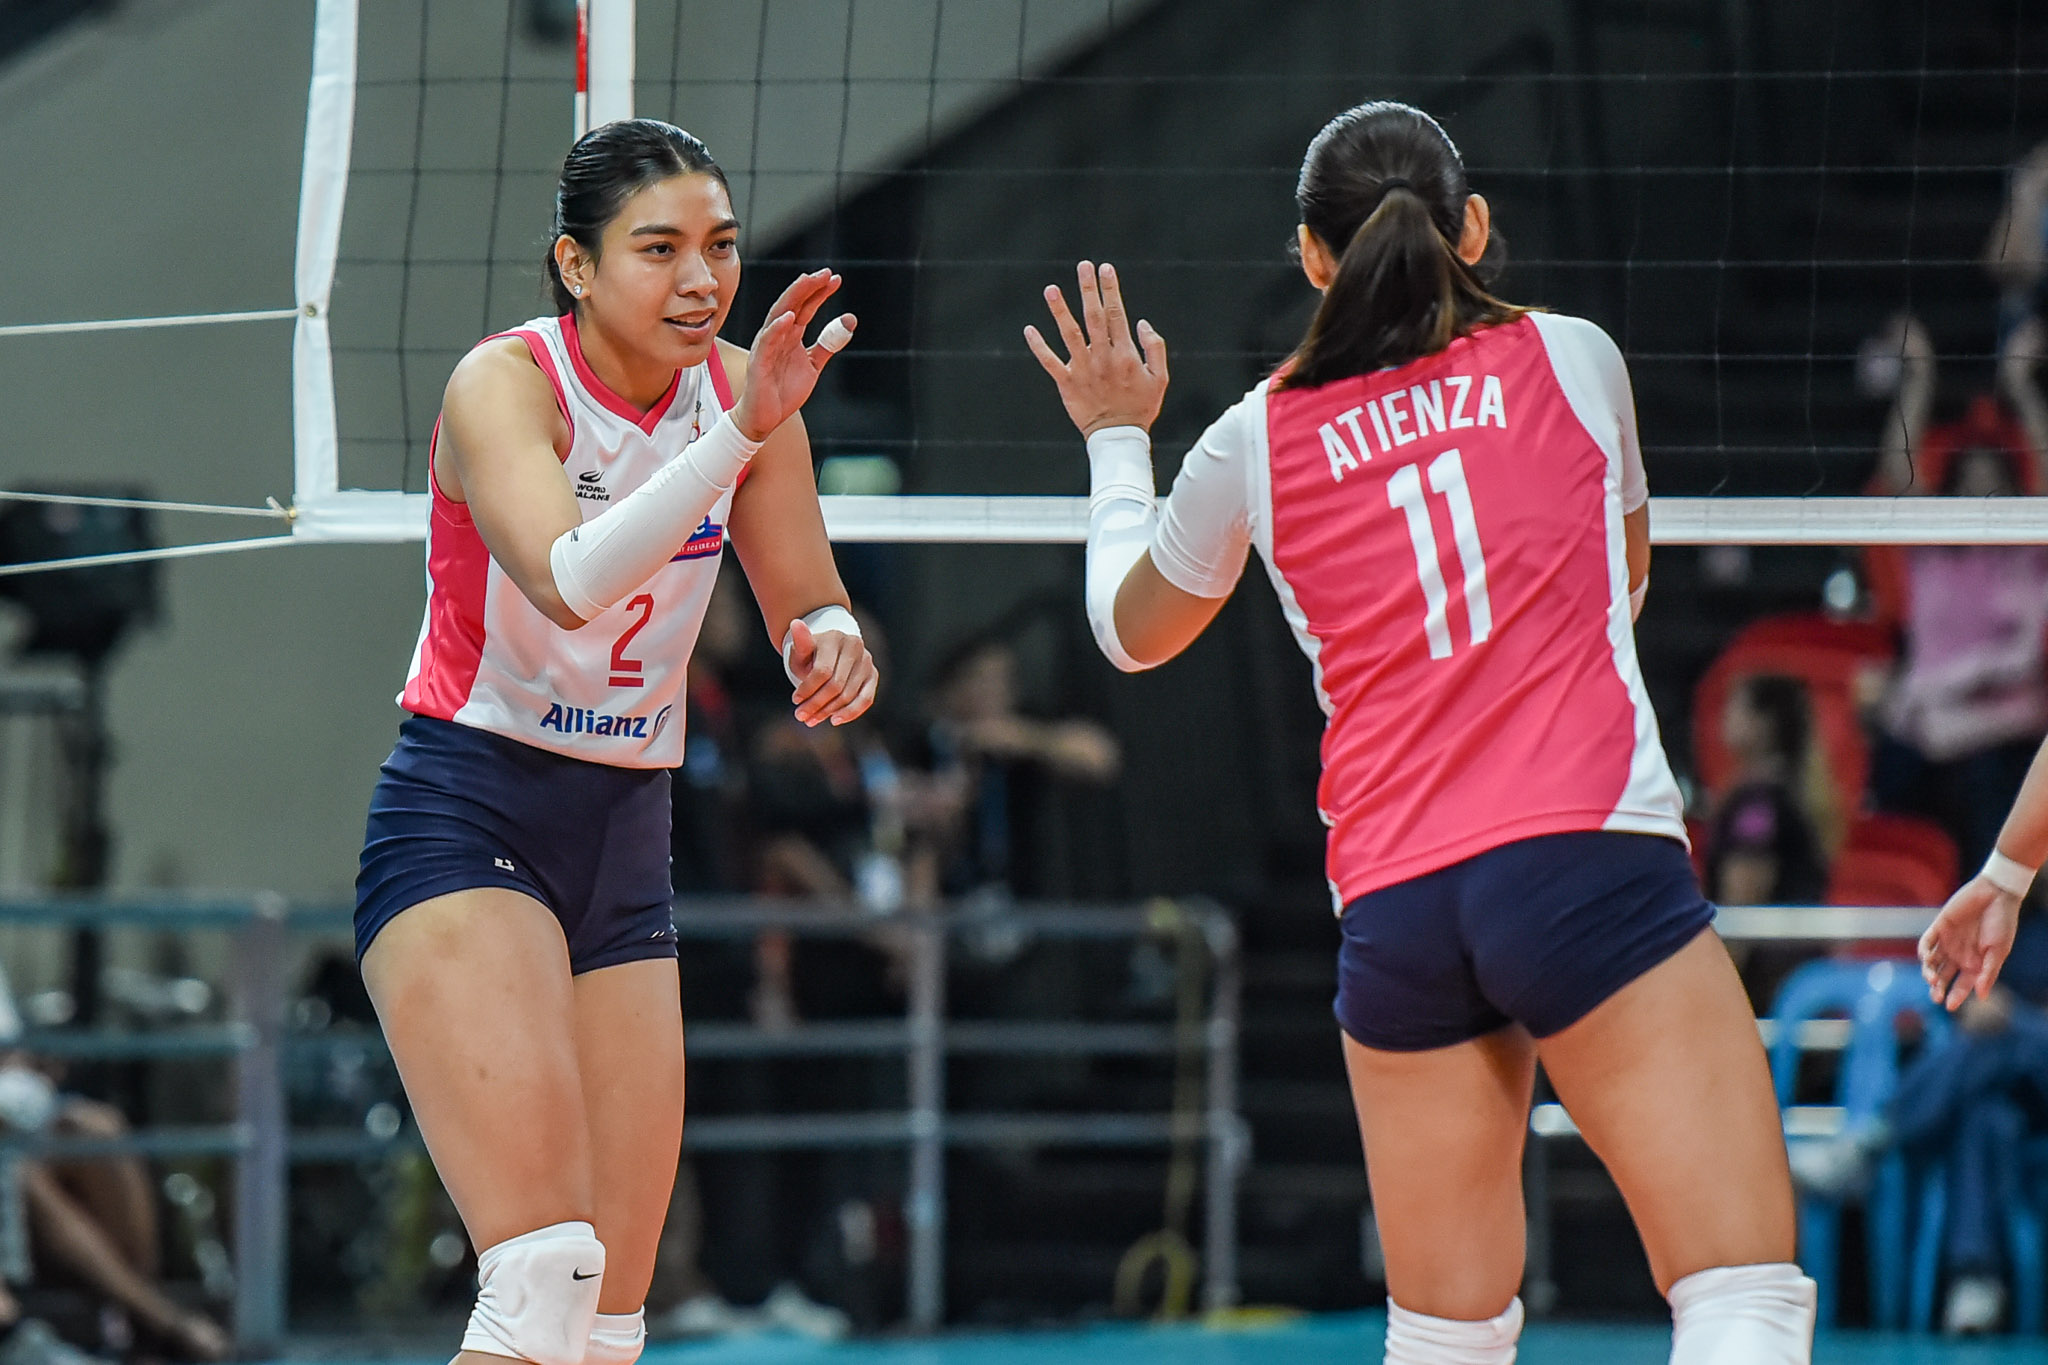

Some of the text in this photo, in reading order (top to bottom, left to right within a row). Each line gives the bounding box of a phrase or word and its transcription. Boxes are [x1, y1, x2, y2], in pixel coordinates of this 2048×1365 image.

[1318, 374, 1507, 483] ATIENZA
[1386, 448, 1493, 660] 11
[608, 593, 654, 673] 2
[540, 702, 648, 738] Allianz
